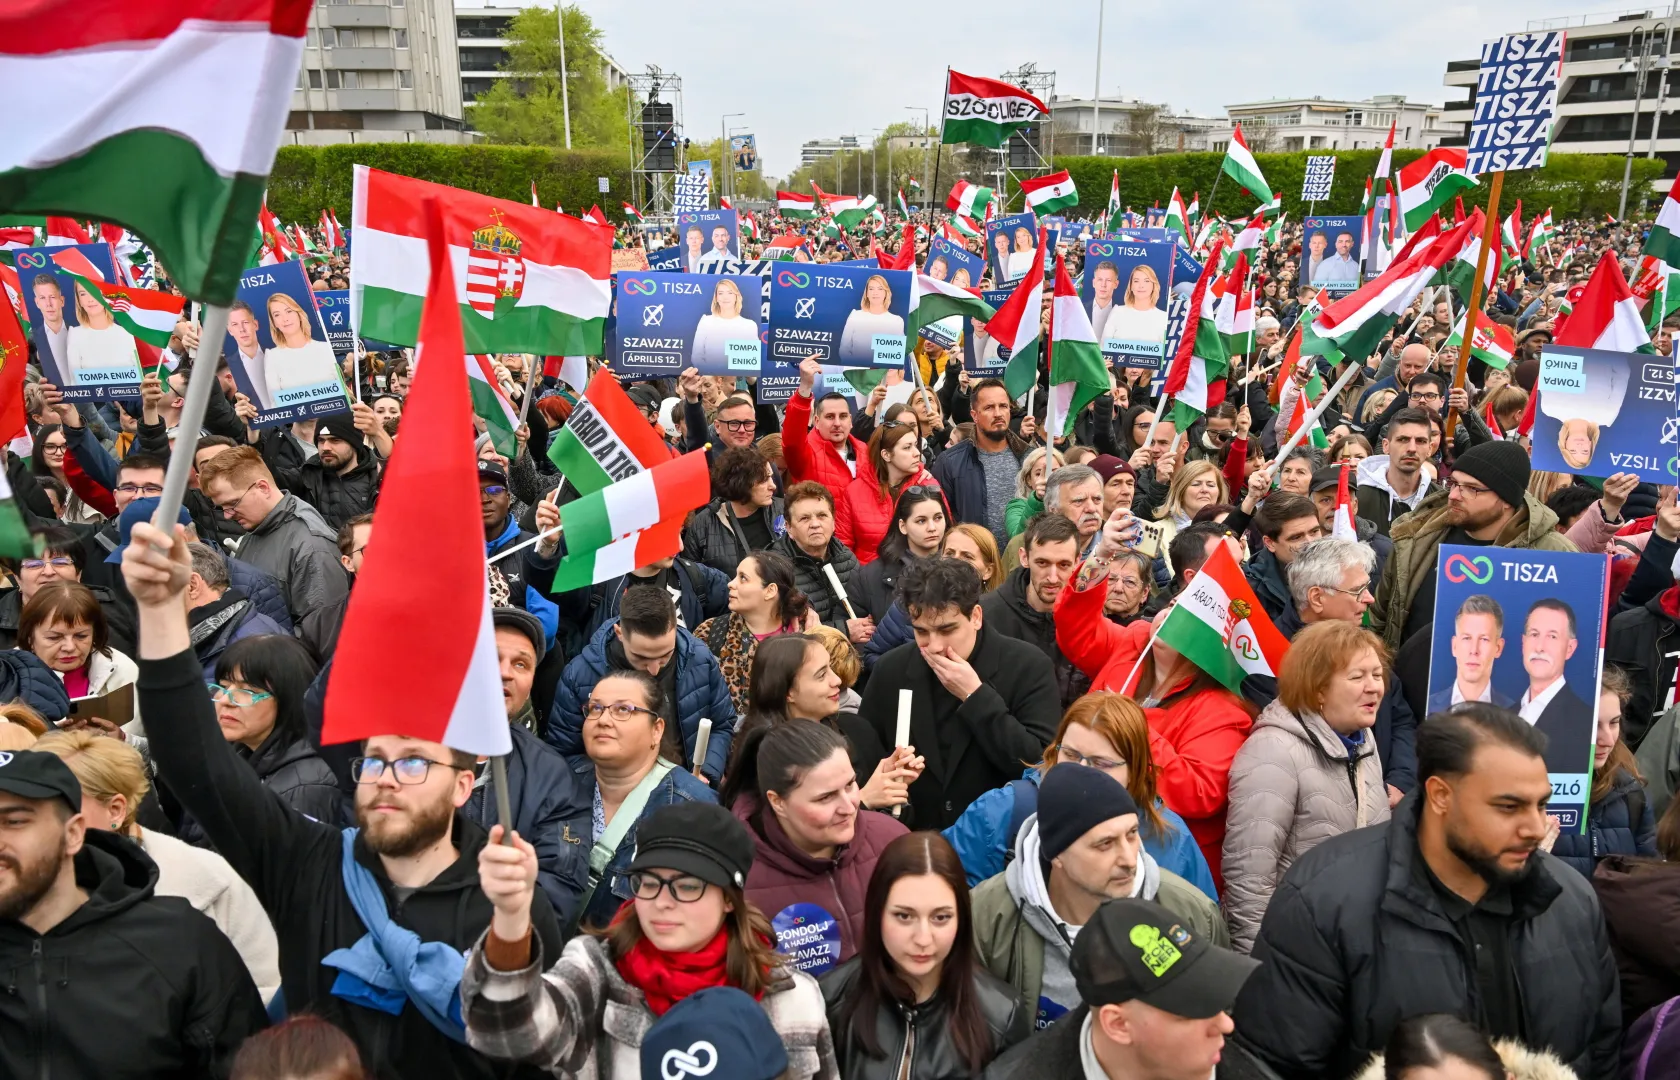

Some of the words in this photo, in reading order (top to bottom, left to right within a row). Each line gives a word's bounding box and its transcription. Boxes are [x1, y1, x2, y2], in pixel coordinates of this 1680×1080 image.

[1481, 32, 1563, 64] TISZA
[1478, 61, 1558, 93] TISZA
[1474, 89, 1554, 121] TISZA
[1469, 118, 1549, 149] TISZA
[1307, 156, 1335, 165] TISZA
[1465, 145, 1546, 176] TISZA
[1305, 165, 1334, 174] TISZA
[675, 174, 709, 186] TISZA
[1303, 174, 1332, 184] TISZA
[674, 185, 709, 196] TISZA
[1302, 184, 1331, 192] TISZA
[674, 195, 709, 206] TISZA
[1301, 192, 1329, 201] TISZA
[1004, 218, 1021, 227] TISZA
[952, 249, 970, 264] TISZA
[1117, 246, 1148, 257] TISZA
[698, 260, 772, 277] TISZA
[1181, 257, 1197, 274] TISZA
[240, 273, 276, 289] TISZA
[815, 276, 854, 290] TISZA
[662, 283, 703, 295] TISZA
[336, 297, 350, 305] TIS
[774, 329, 833, 342] SZAVAZZ!
[623, 337, 684, 349] SZAVAZZ!
[728, 344, 758, 352] TOMPA
[875, 338, 903, 347] TOMPA
[1108, 343, 1134, 351] TOMPA
[1136, 344, 1160, 353] ENIKŐ
[778, 344, 813, 355] ÁPRILIS
[877, 351, 902, 360] ENIKŐ
[627, 353, 664, 364] ÁPRILIS
[665, 356, 677, 364] 12.
[732, 357, 758, 366] ENIKŐ
[1545, 359, 1578, 370] ENIKŐ
[79, 371, 110, 381] TOMPA
[111, 369, 138, 380] ENIKŐ
[1648, 368, 1664, 379] 12.
[1543, 376, 1580, 388] TOMPA
[279, 391, 311, 402] TOMPA
[312, 383, 340, 396] ENIKŐ
[765, 389, 791, 397] ÁPRILIS
[253, 409, 293, 424] SZAVAZZ!
[313, 403, 332, 411] ÁPRILIS
[567, 400, 610, 449] ÁRAD
[593, 438, 618, 464] A
[604, 450, 641, 482] TIS
[1609, 452, 1660, 471] TISZA
[1501, 562, 1559, 583] TISZA
[1191, 585, 1213, 607] ÁRAD
[1210, 601, 1218, 612] A
[1562, 814, 1573, 823] 12.
[784, 942, 790, 950] A
[790, 934, 825, 948] HAZÁDRA
[784, 943, 831, 964] ZAVAZZ
[1150, 947, 1176, 972] NER
